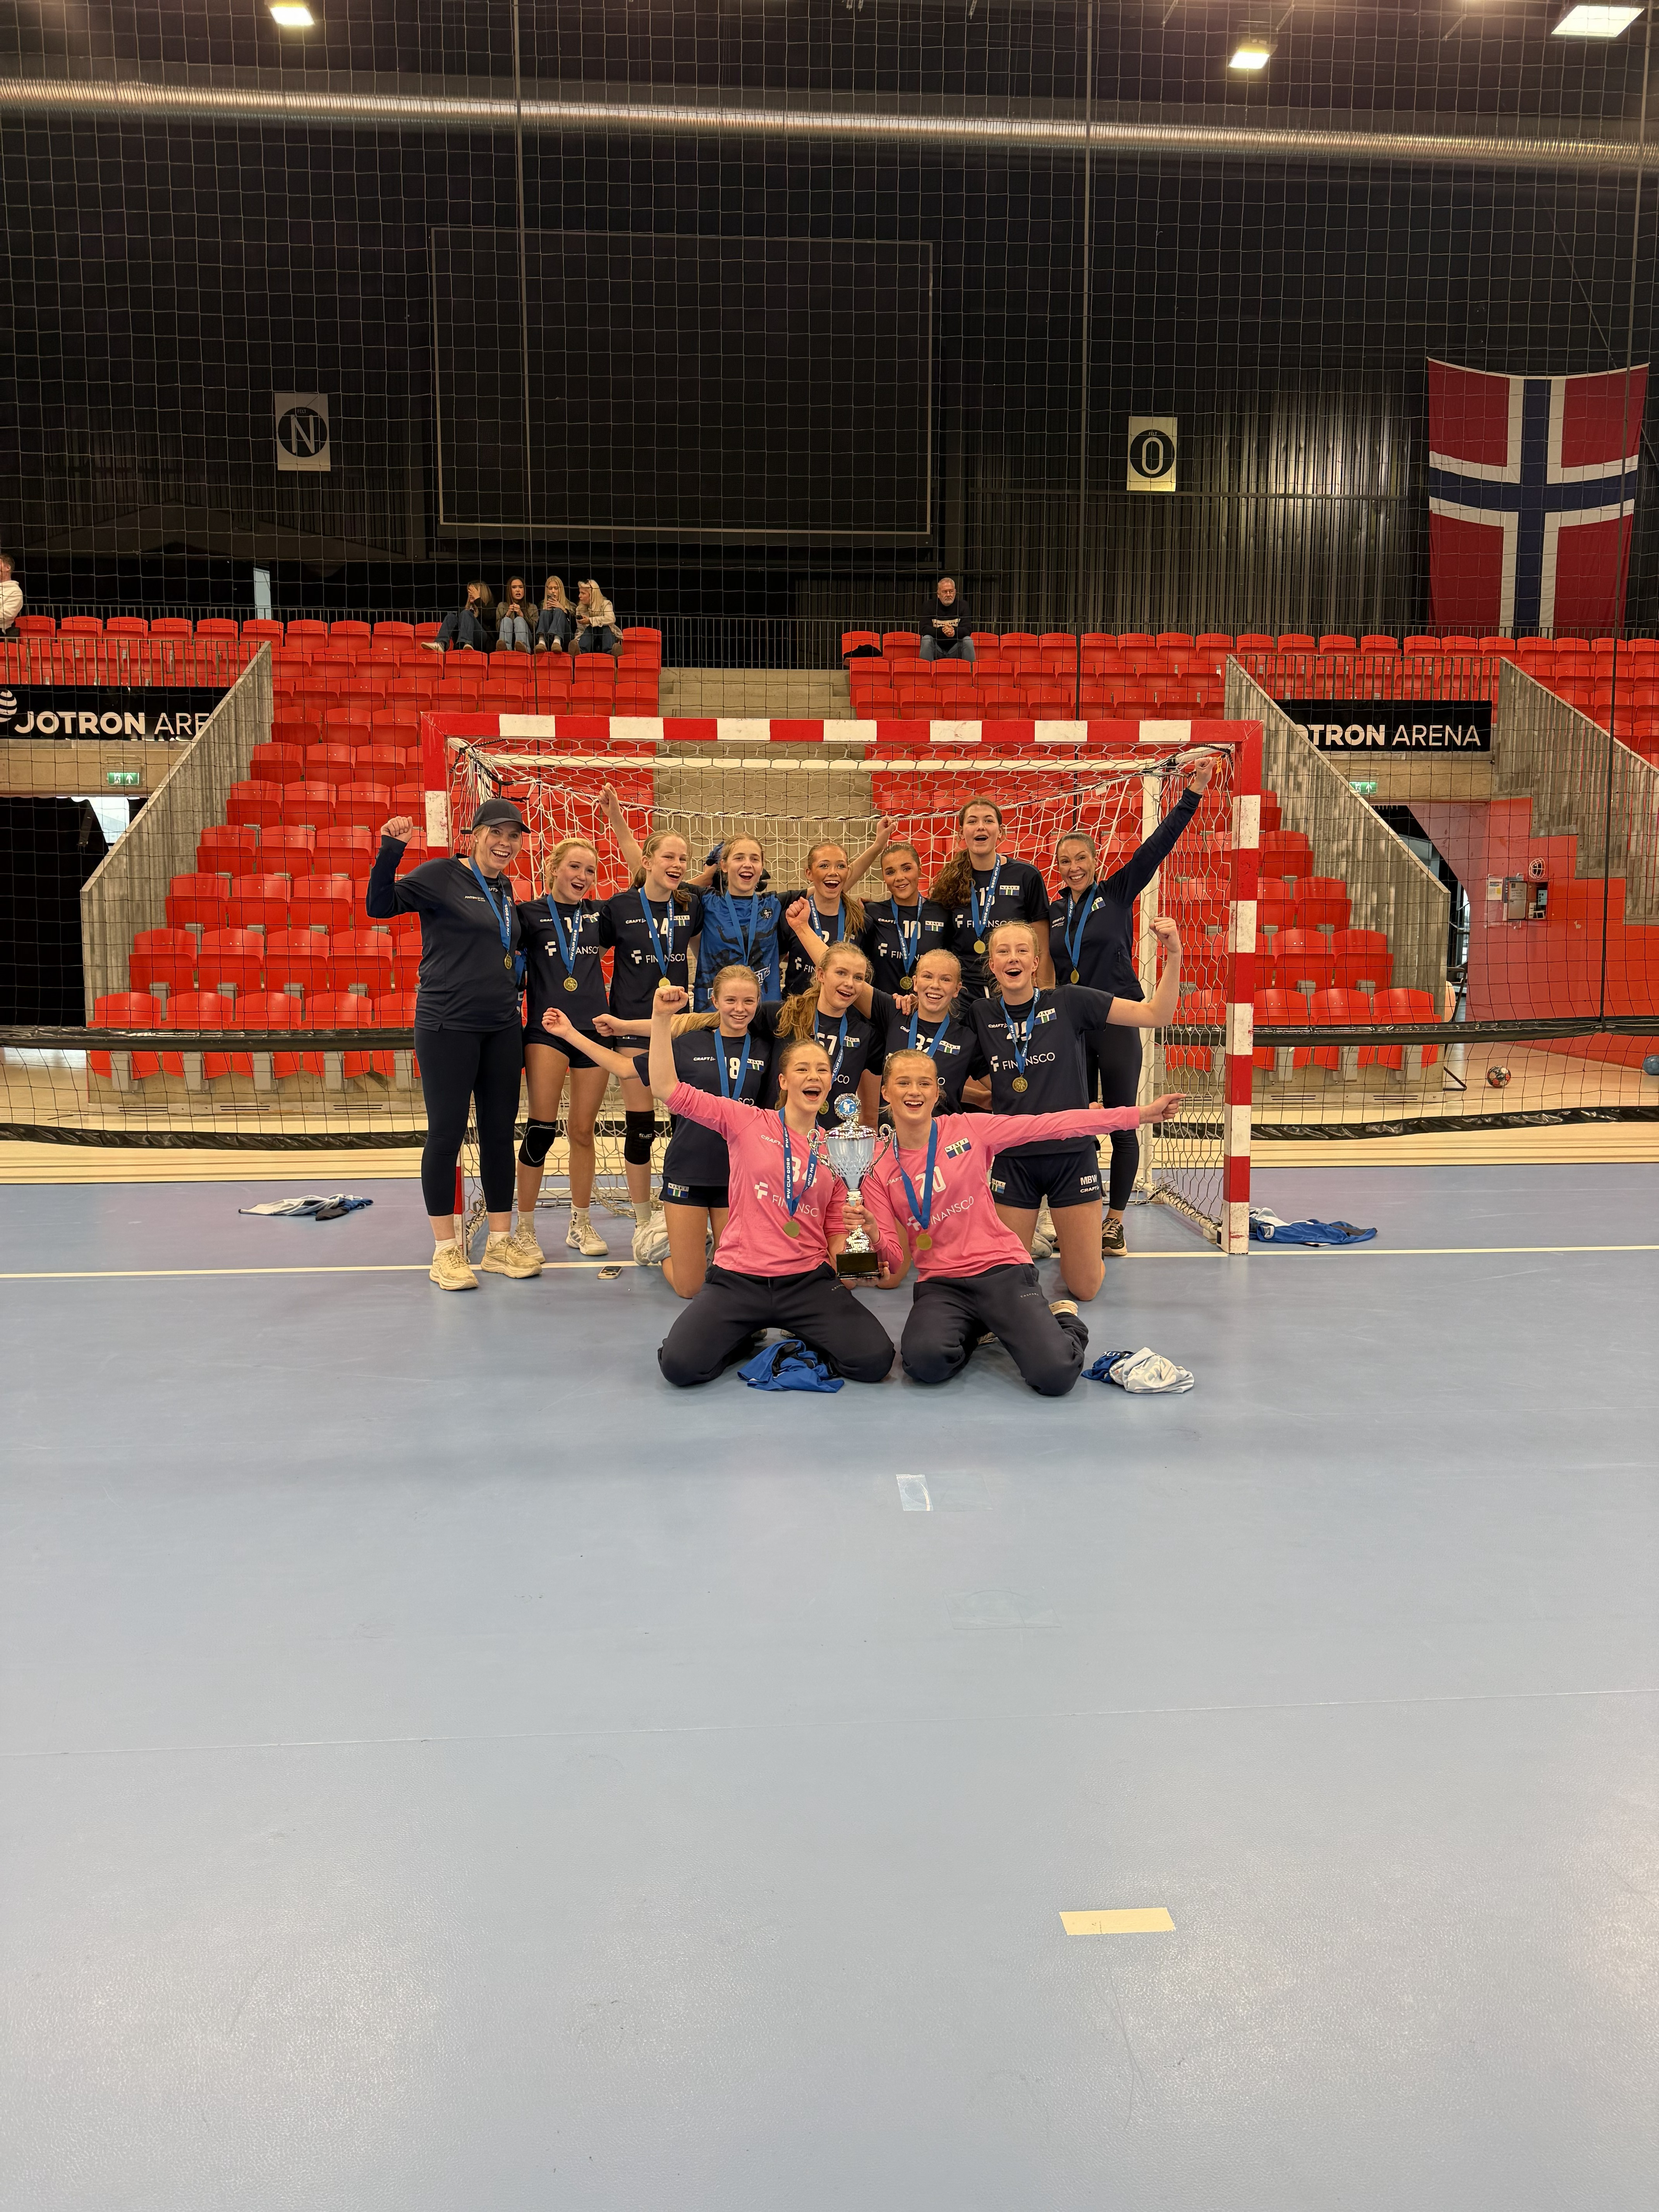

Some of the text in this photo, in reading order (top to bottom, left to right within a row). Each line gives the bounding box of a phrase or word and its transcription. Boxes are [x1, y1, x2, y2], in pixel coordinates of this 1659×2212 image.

[291, 414, 315, 453] N
[14, 711, 145, 734] JOTRON
[1392, 725, 1481, 746] ARENA
[903, 920, 921, 939] 10
[646, 953, 685, 963] FINNSCO
[1002, 1052, 1055, 1070] FINNSCO
[761, 1134, 781, 1146] CRAFT
[785, 1138, 789, 1148] PW
[810, 1163, 814, 1173] PW
[787, 1189, 790, 1199] PW
[772, 1194, 819, 1217] FINNSC
[930, 1196, 974, 1225] INANSCO
